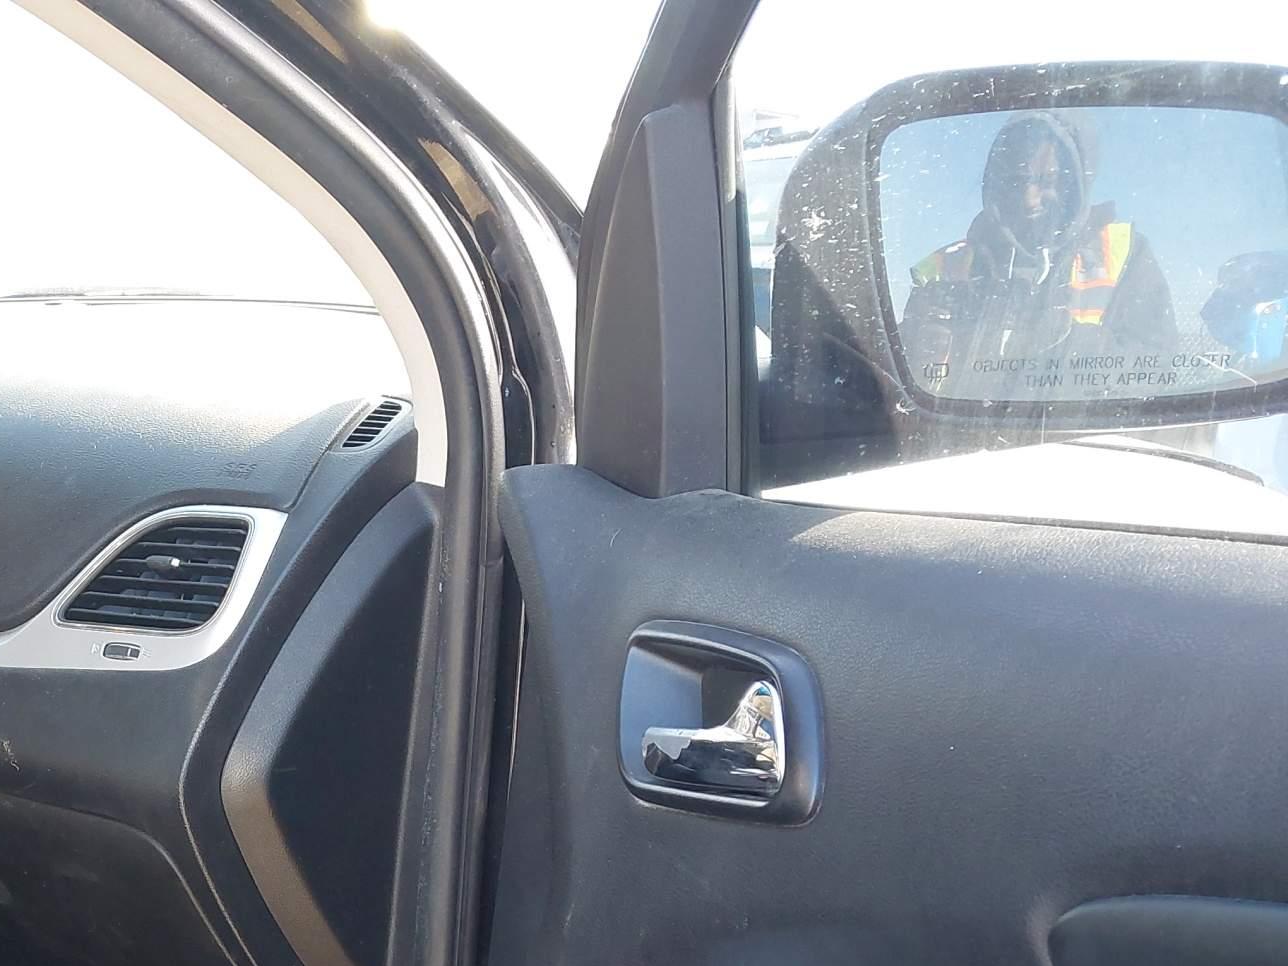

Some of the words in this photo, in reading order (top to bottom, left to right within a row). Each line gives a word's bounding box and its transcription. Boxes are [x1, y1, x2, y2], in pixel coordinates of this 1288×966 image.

[973, 358, 1038, 373] OBJECTS
[1045, 356, 1060, 370] IN
[1069, 355, 1126, 370] MIRROR
[1132, 354, 1161, 368] ARE
[1171, 353, 1232, 369] CLOSER
[1024, 373, 1065, 388] THAN
[1074, 372, 1111, 386] THEY
[1116, 371, 1178, 386] APPEAR
